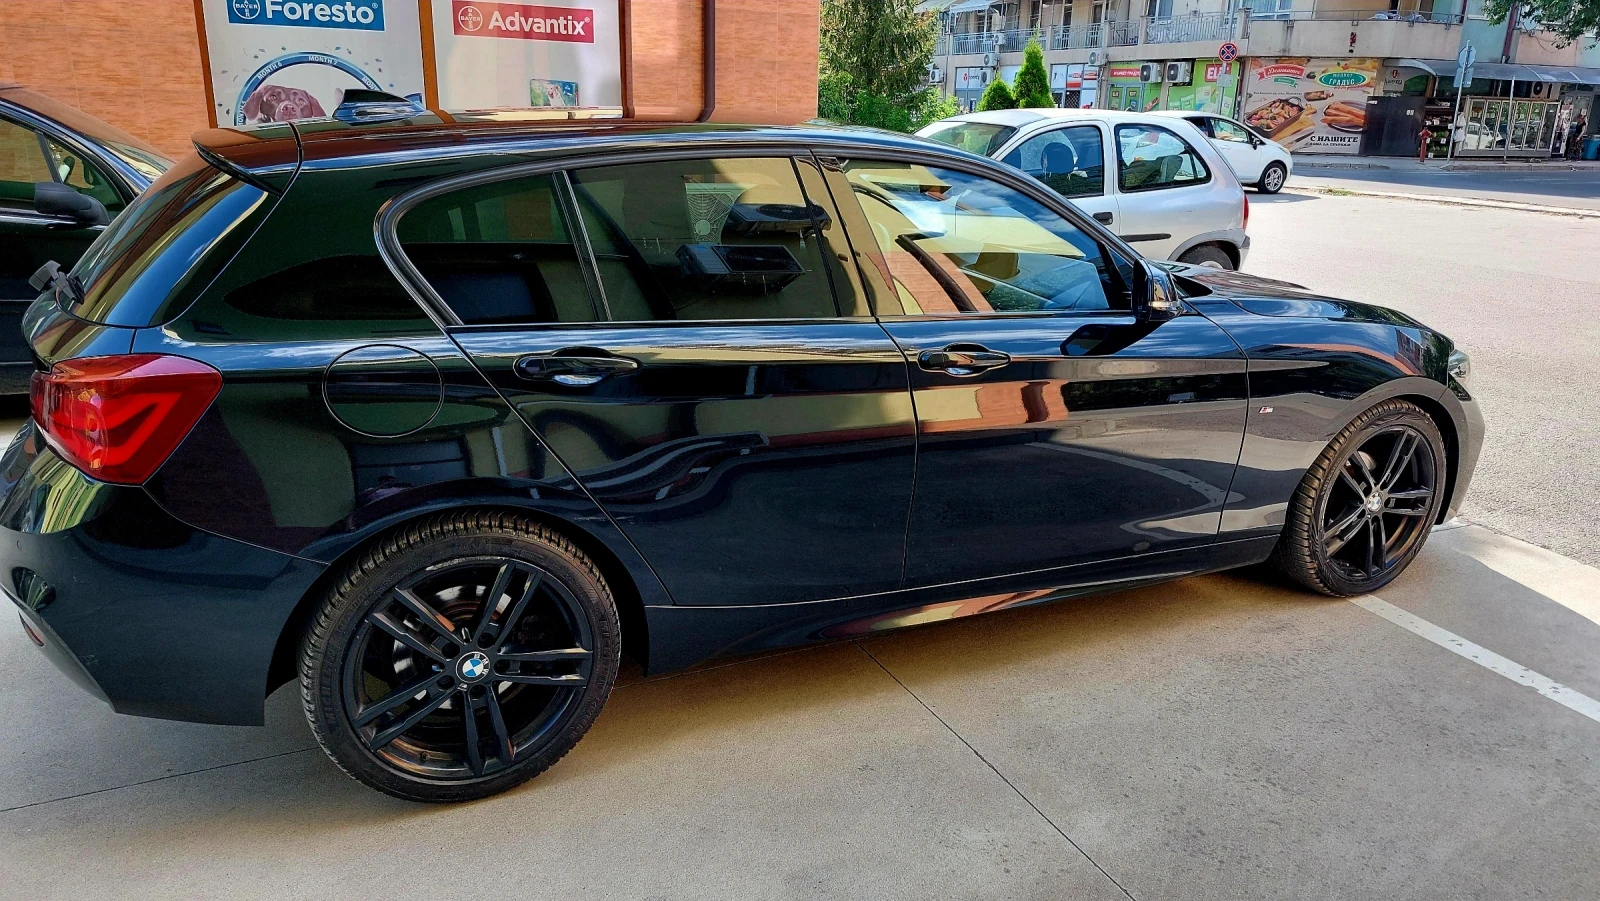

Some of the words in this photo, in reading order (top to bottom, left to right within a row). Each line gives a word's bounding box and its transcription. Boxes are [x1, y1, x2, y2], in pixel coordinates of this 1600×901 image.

[308, 55, 332, 65] MONTH
[257, 64, 278, 80] MONTH
[1328, 78, 1355, 86] ГРАДУС
